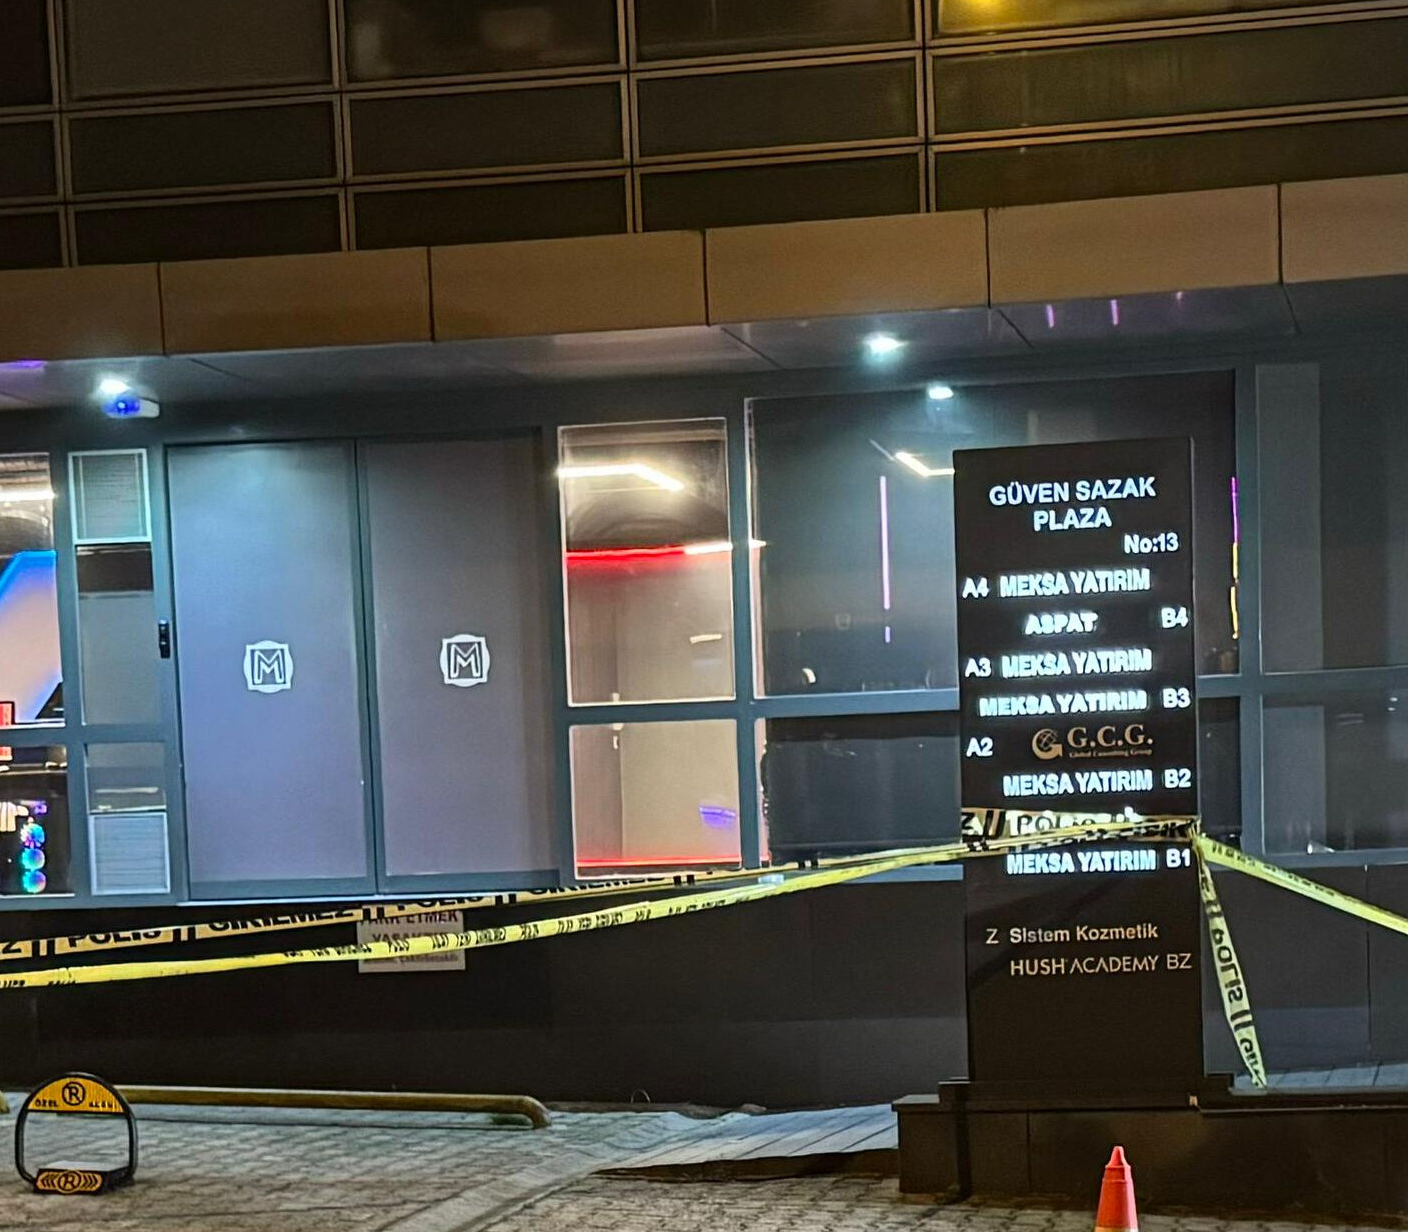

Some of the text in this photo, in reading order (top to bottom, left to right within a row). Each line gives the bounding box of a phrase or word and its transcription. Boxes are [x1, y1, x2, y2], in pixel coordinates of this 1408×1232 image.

[989, 477, 1156, 505] GÜVEN SAZAK
[1033, 507, 1112, 531] PLAZA
[1124, 533, 1179, 554] No:13
[962, 577, 990, 598] A4
[1000, 568, 1151, 597] MEKSA YATIRIM
[1025, 612, 1098, 635] ASPAT
[1161, 607, 1189, 629] B4
[965, 658, 992, 677] A3
[1002, 649, 1152, 678] MEKSA YATIRIM
[979, 690, 1147, 717] MEKSA YATIRIM
[1163, 688, 1191, 709] B3
[966, 737, 993, 757] A2
[1003, 769, 1153, 797] MEKSA YATIRIM
[1164, 768, 1192, 789] B2
[1007, 849, 1157, 875] MEKSA YATIRIM
[1166, 848, 1191, 868] B1
[985, 928, 999, 944] Z
[1009, 922, 1159, 943] Sistem Kozmetik
